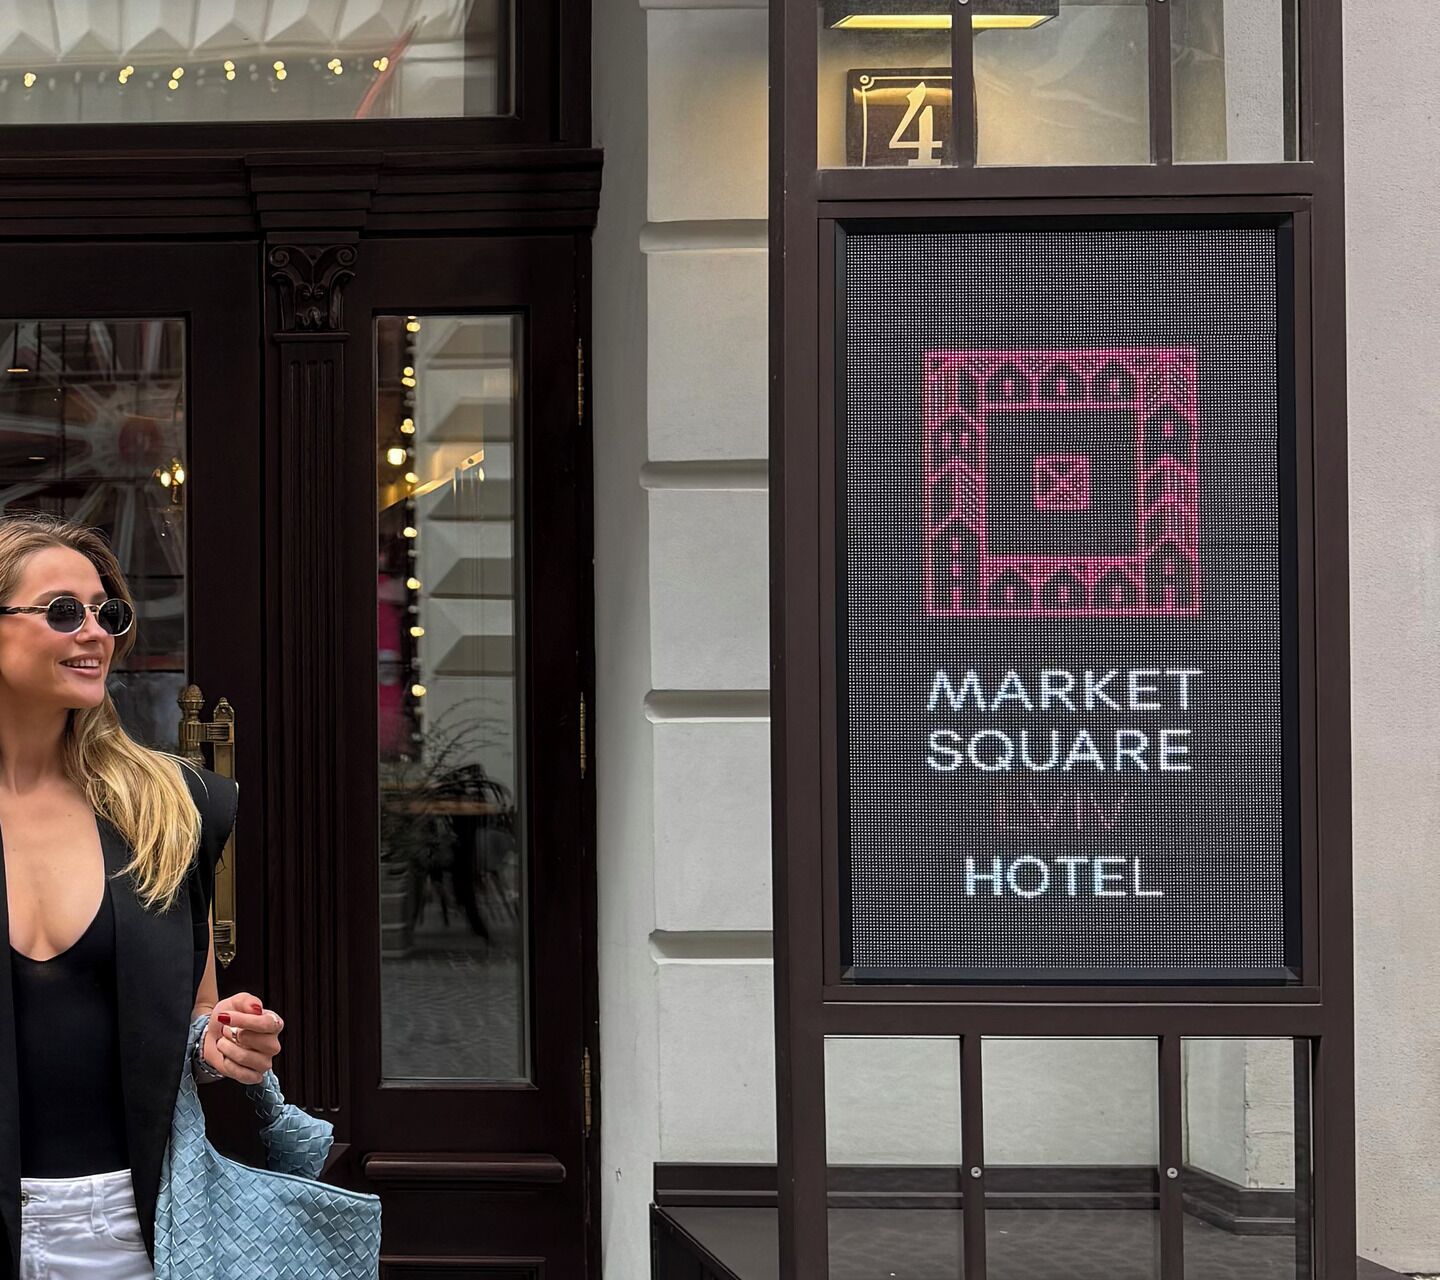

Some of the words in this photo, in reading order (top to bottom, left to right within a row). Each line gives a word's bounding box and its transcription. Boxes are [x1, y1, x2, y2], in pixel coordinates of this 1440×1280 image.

[888, 81, 943, 167] 4
[927, 669, 1204, 711] MARKET
[927, 729, 1193, 771] SQUARE
[996, 792, 1128, 830] LVIV
[965, 855, 1165, 898] HOTEL
